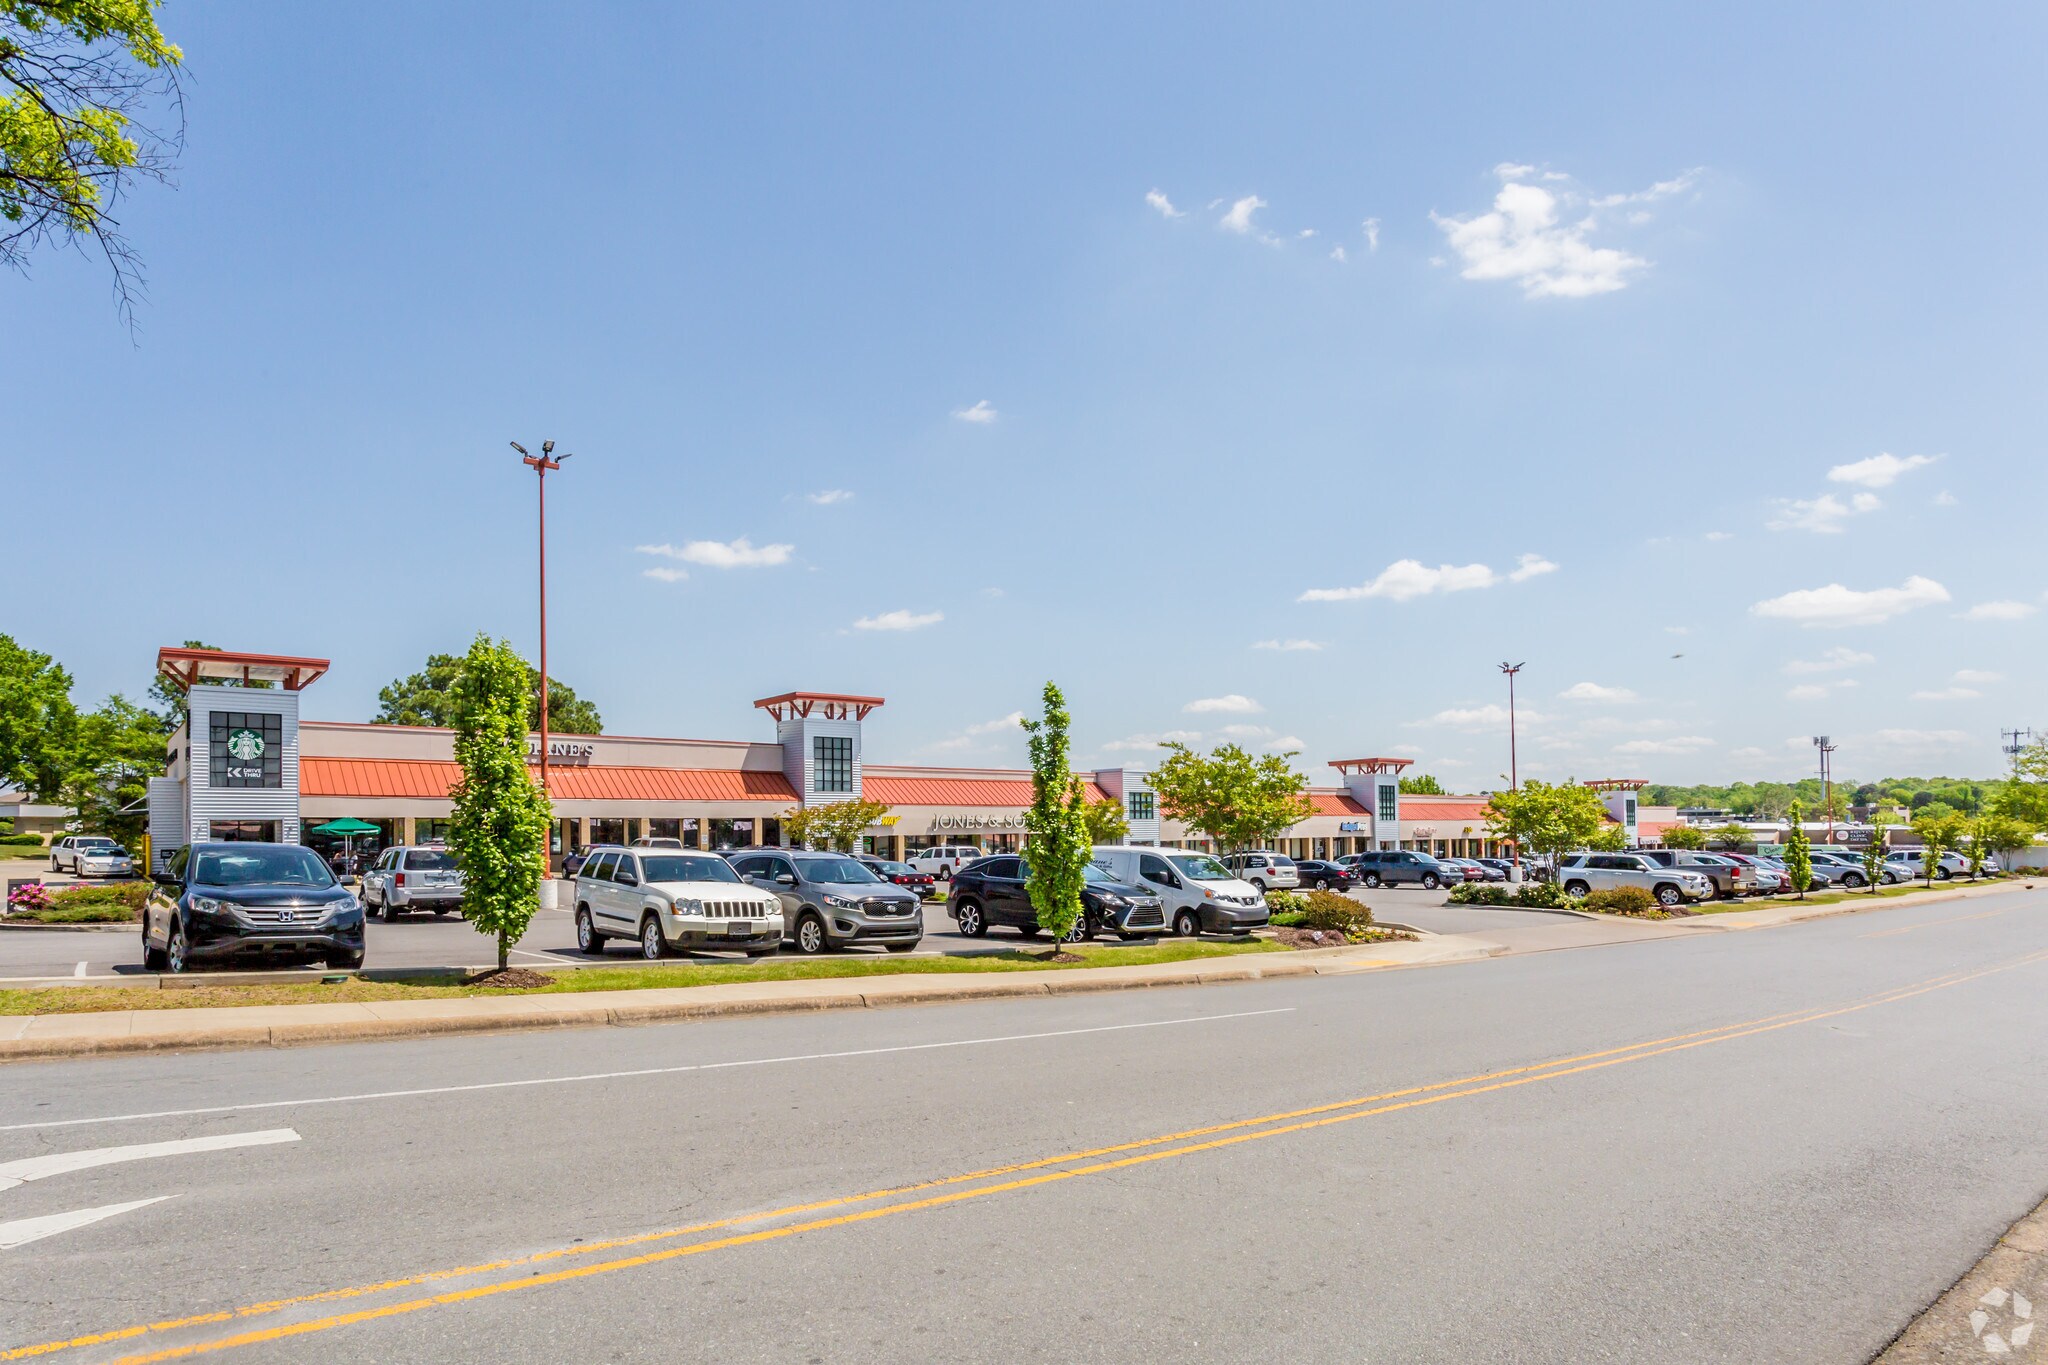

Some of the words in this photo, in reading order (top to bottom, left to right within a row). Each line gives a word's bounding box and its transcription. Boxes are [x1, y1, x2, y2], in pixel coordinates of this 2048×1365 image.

[527, 743, 594, 757] IANE'S
[934, 813, 983, 831] JONES
[988, 814, 1001, 828] &
[1005, 814, 1027, 829] SO
[1764, 846, 1782, 855] Clean
